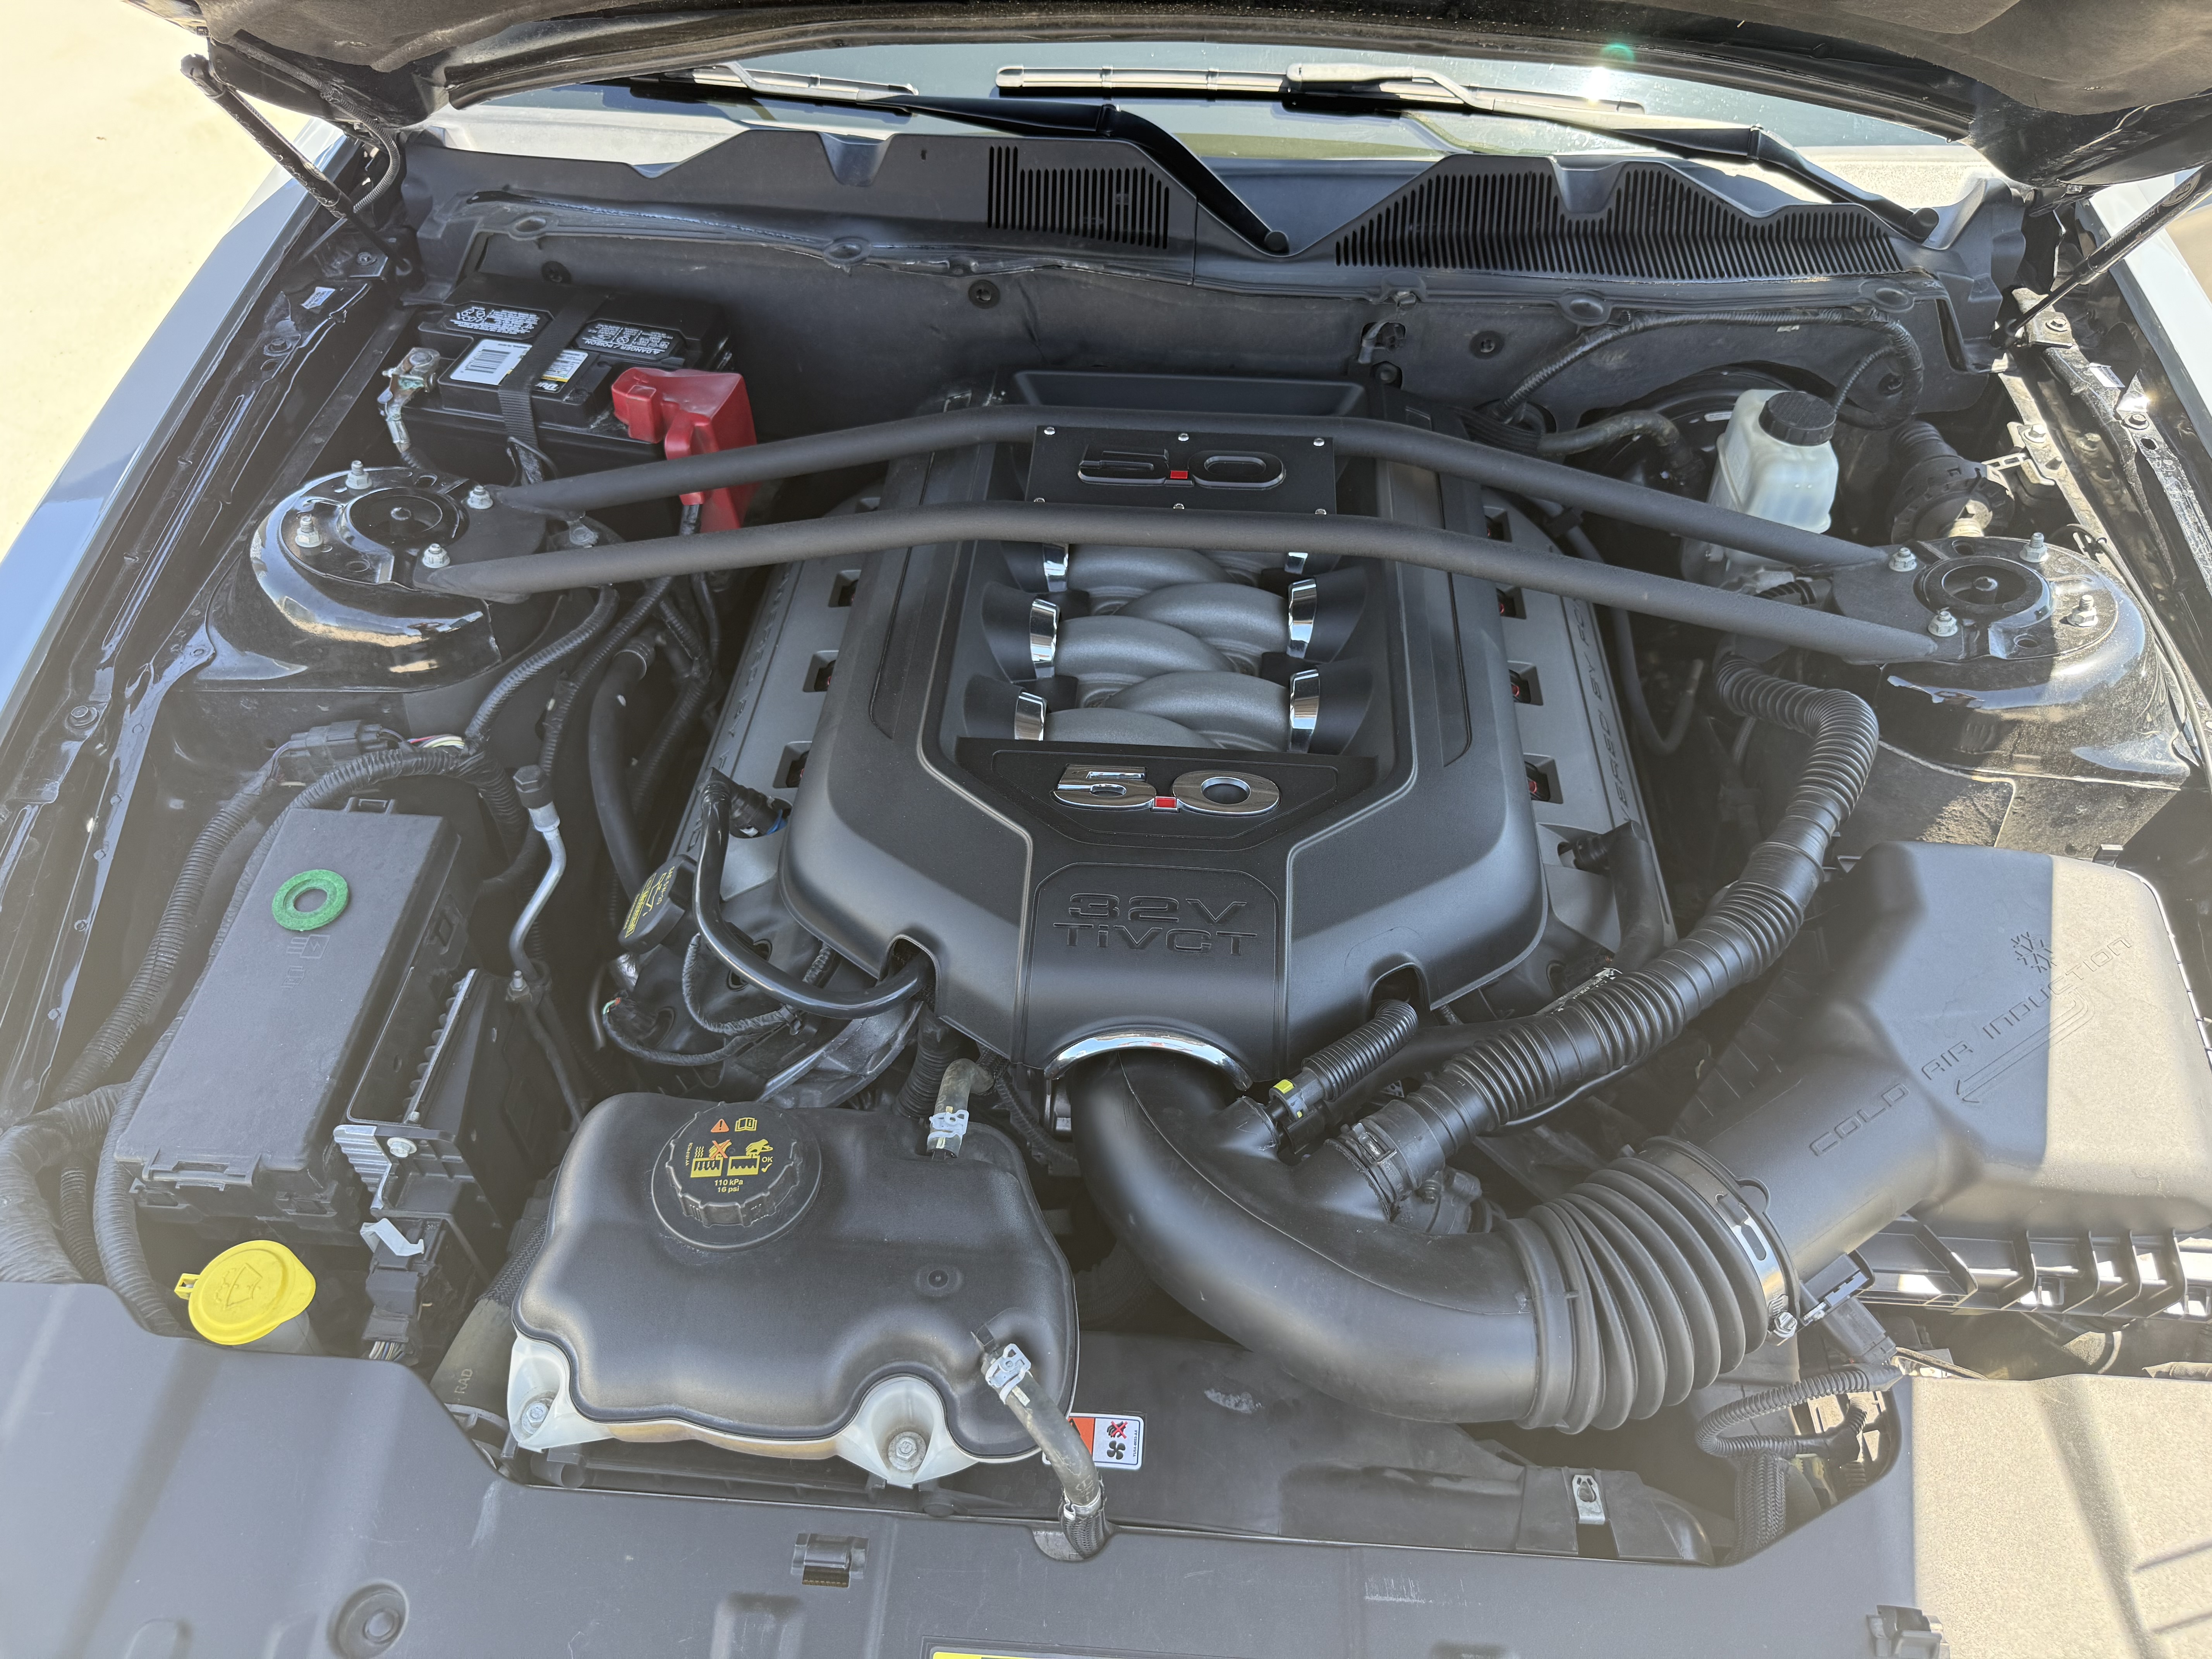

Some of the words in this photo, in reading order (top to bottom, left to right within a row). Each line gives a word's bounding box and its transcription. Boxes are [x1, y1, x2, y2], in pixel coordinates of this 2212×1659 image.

[584, 339, 613, 348] POISON
[619, 345, 651, 354] DANGER
[1078, 445, 1286, 489] 5.0
[1051, 764, 1280, 816] 5.0
[1069, 893, 1247, 926] 32V
[1053, 922, 1257, 956] TiVCT
[1809, 1083, 1909, 1156] COLD
[1921, 1039, 1974, 1080] AIR
[1982, 936, 2132, 1040] INDUCTION
